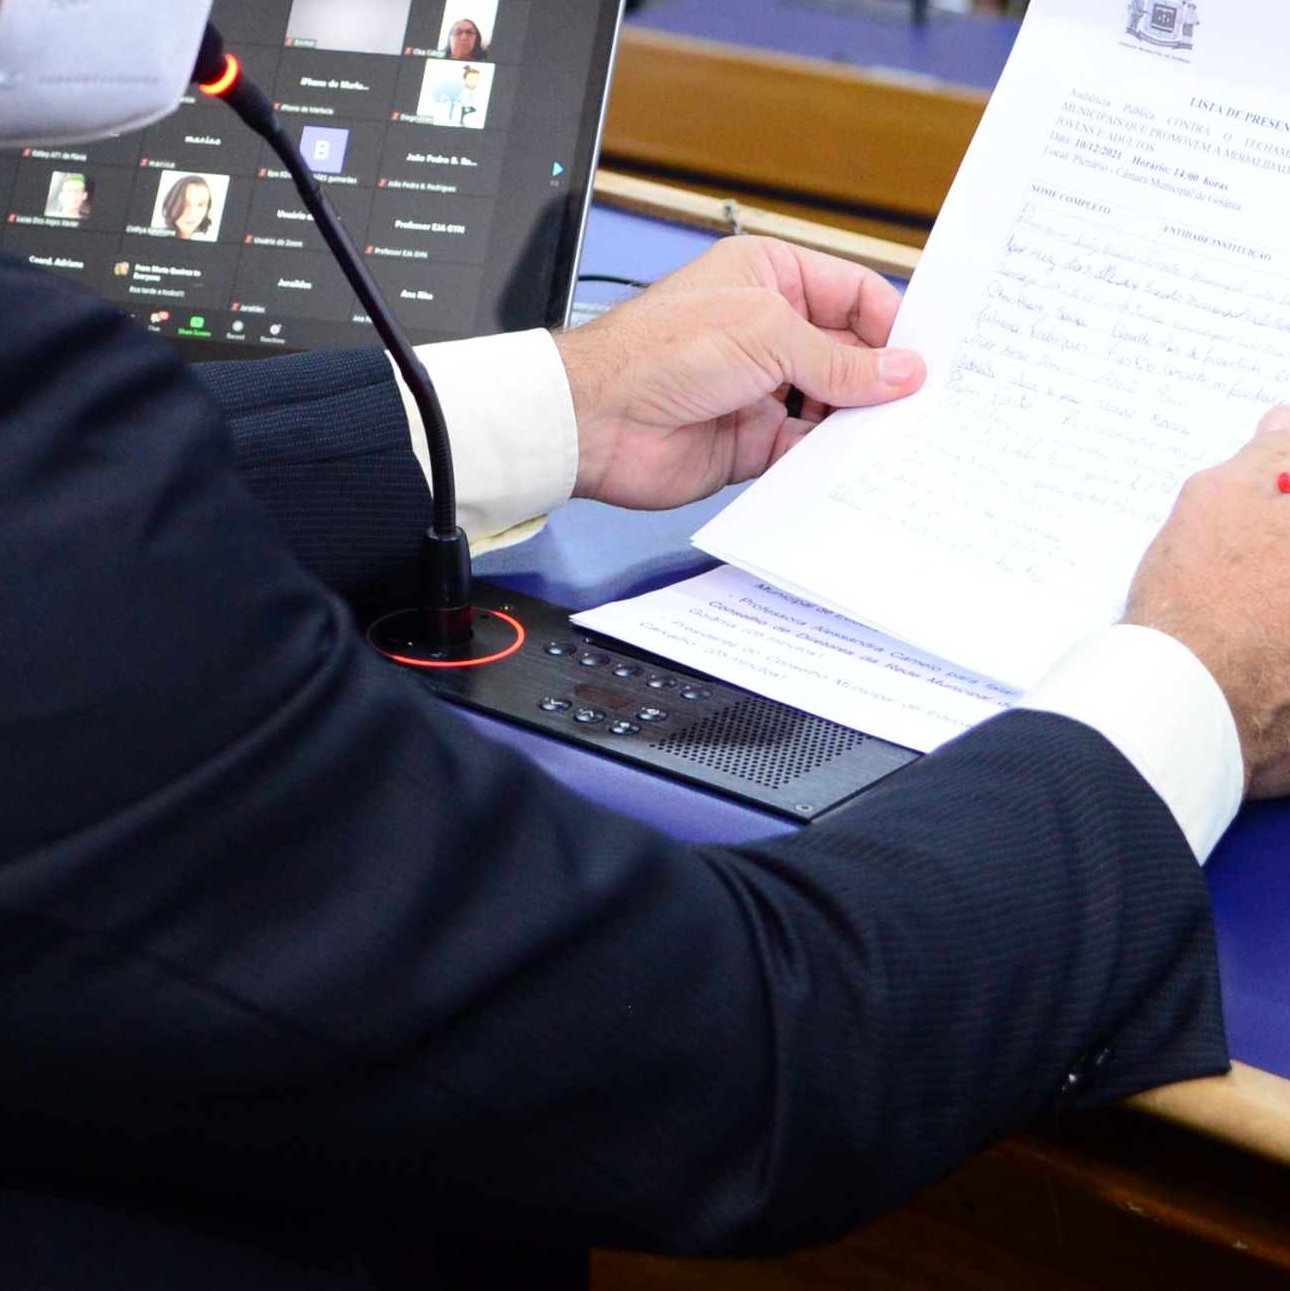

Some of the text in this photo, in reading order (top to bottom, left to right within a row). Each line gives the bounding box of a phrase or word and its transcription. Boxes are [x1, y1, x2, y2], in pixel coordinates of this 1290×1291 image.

[1055, 116, 1096, 136] JOVENS
[1062, 101, 1124, 128] MUNICIPAIS
[1125, 120, 1149, 136] QUE
[1149, 127, 1212, 153] PROMOVEM
[1189, 96, 1223, 115] LISTA
[1225, 107, 1243, 121] DE
[1167, 116, 1211, 137] CONTRA
[1223, 131, 1233, 142] O
[313, 139, 331, 160] B
[1075, 138, 1124, 161] 10/12/2021
[1131, 154, 1172, 176] Horário:
[1173, 166, 1200, 184] 14:00
[1202, 175, 1230, 192] horas
[1071, 153, 1110, 175] Plenário
[1115, 166, 1149, 186] Câmara
[1148, 175, 1194, 200] Municipal
[1194, 189, 1207, 203] de
[1207, 194, 1243, 213] Goiânia
[395, 218, 466, 235] Professor EJA GYN
[1031, 183, 1058, 200] NOME
[1059, 192, 1112, 215] COMPLETO
[1162, 223, 1273, 263] ENTIDADE/INSTITUIÇÃO
[374, 246, 402, 257] Professor
[400, 288, 417, 299] Ana
[177, 327, 212, 338] Share Screen
[689, 608, 737, 629] Goiânia
[766, 636, 824, 659] minutos)
[709, 601, 768, 626] Conselho
[772, 624, 791, 634] de
[795, 632, 855, 656] Diretores
[860, 655, 879, 665] da
[883, 662, 922, 679] Rede
[926, 676, 995, 701] Municipal
[739, 596, 808, 627] Professora
[810, 624, 885, 654] Alessandra
[890, 650, 943, 673] Camelo
[944, 671, 980, 685] para
[670, 619, 738, 648] Presidente
[742, 646, 762, 656] do
[766, 655, 828, 681] Conselho
[830, 677, 900, 703] Municipal
[902, 702, 922, 712] de
